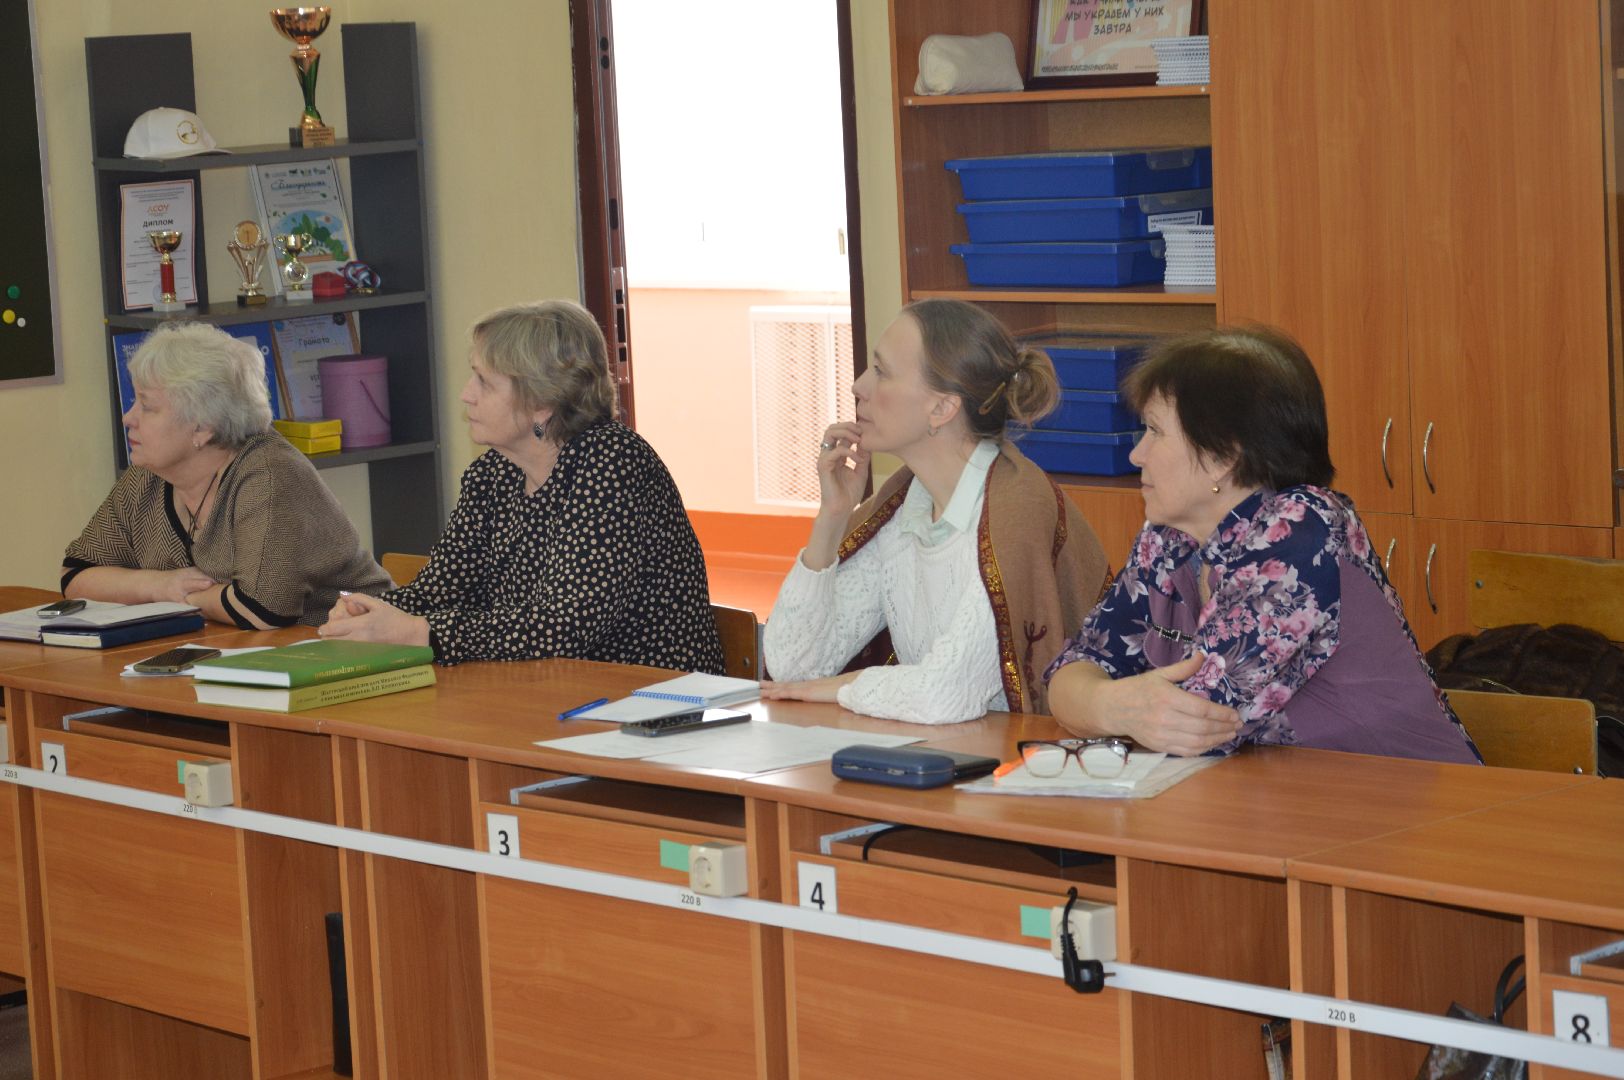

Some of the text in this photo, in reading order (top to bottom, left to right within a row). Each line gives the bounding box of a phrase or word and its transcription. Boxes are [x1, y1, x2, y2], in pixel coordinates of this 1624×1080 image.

[1065, 6, 1164, 21] МЫ УКРАДЕМ У НИХ
[1093, 23, 1132, 35] ЗАВТРА
[142, 218, 174, 228] ДИПЛОМ
[498, 830, 510, 856] 3
[681, 894, 695, 905] 220
[811, 881, 825, 911] 4
[1328, 1008, 1356, 1023] 220 В
[1571, 1014, 1592, 1044] 8
